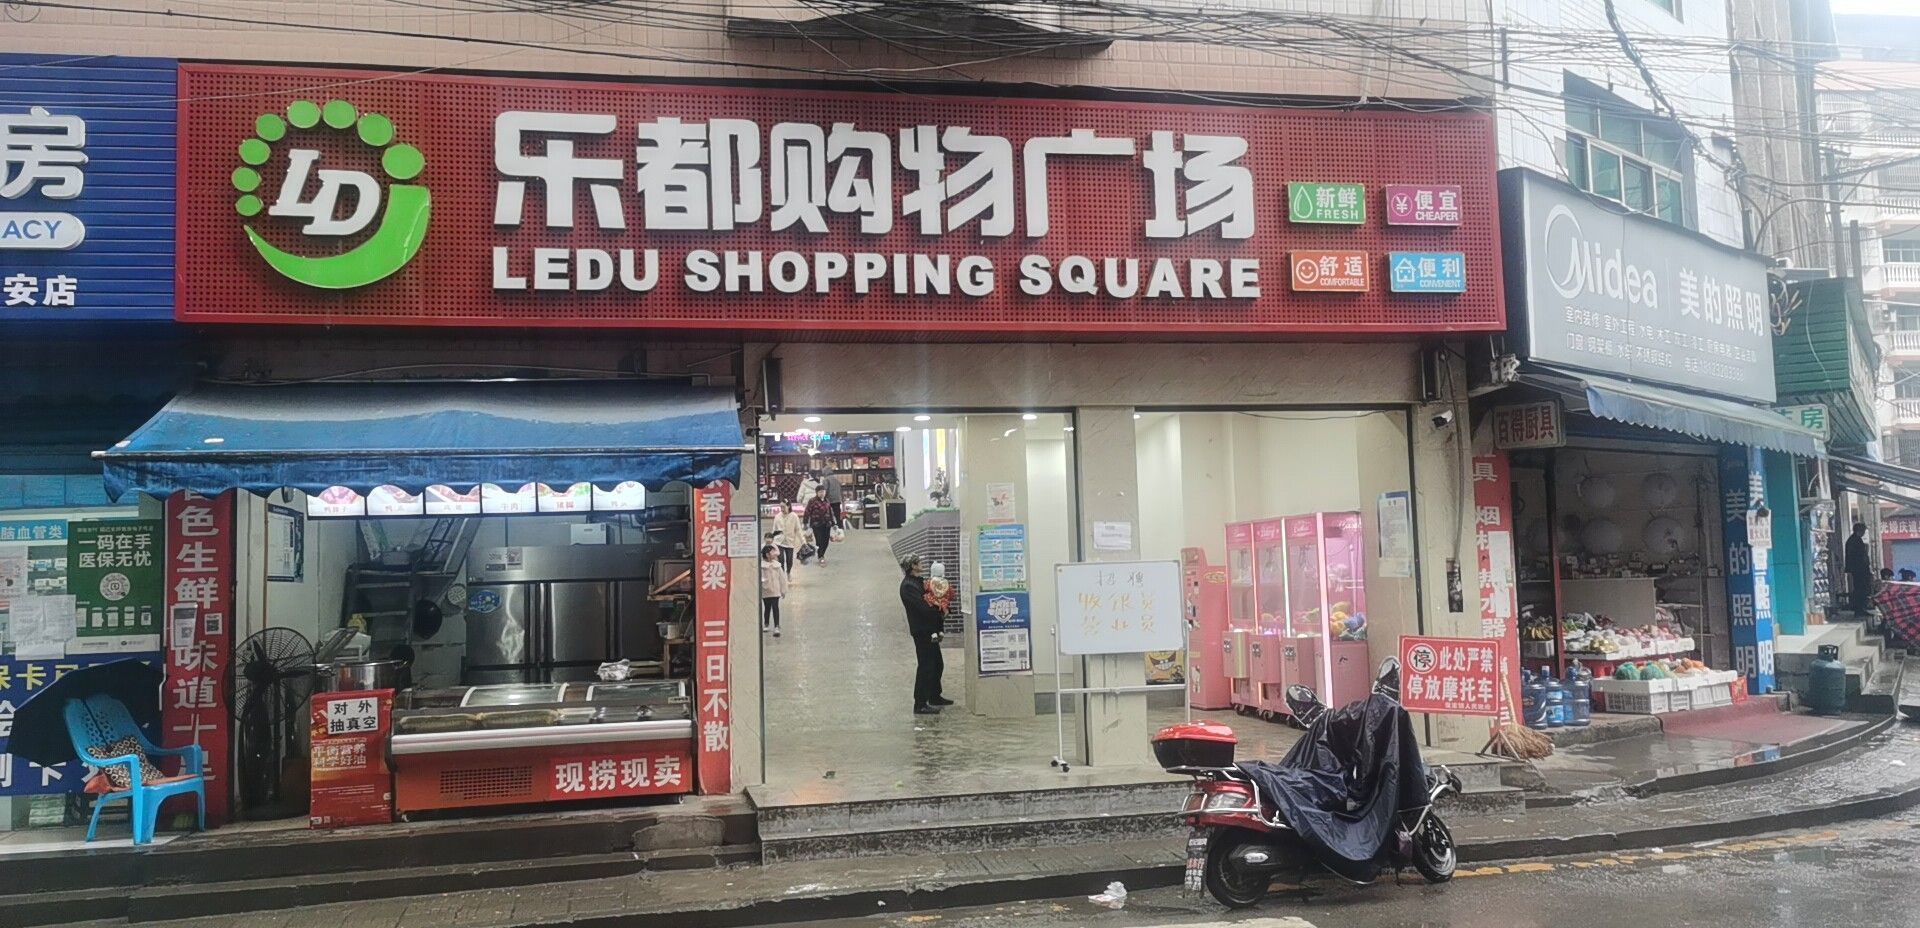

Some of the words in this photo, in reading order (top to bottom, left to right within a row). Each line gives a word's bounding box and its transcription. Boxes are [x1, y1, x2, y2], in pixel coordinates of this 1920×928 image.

[0, 105, 88, 200] 房
[492, 110, 1256, 239] 乐都购物广场
[269, 148, 381, 236] LD
[1316, 187, 1358, 209] 新鲜
[1414, 190, 1458, 211] 便宜
[1316, 209, 1359, 220] FRESH
[1415, 211, 1458, 221] CHEAPER
[492, 246, 660, 292] LEDU
[684, 249, 995, 297] SHOPPING
[1019, 254, 1262, 299] SQUARE
[1319, 255, 1363, 277] 舒适
[1418, 257, 1460, 278] 便利
[1554, 230, 1658, 309] Midea
[2, 273, 78, 307] 安店
[1320, 277, 1364, 287] COMFORTABLE
[1419, 279, 1461, 289] CONVENIENT
[1679, 266, 1765, 338] 美的照明
[1564, 306, 1600, 329] 室内装修
[1497, 406, 1555, 443] 百得厨具
[78, 533, 152, 550] 一码在手
[79, 550, 152, 568] 医保无忧
[1726, 488, 1757, 679] 美的照明
[1439, 646, 1493, 673] 此处严禁
[702, 619, 729, 753] 三日不散
[1407, 674, 1494, 703] 停放摩托车
[330, 716, 376, 733] 抽真空
[556, 756, 682, 794] 现捞现卖
